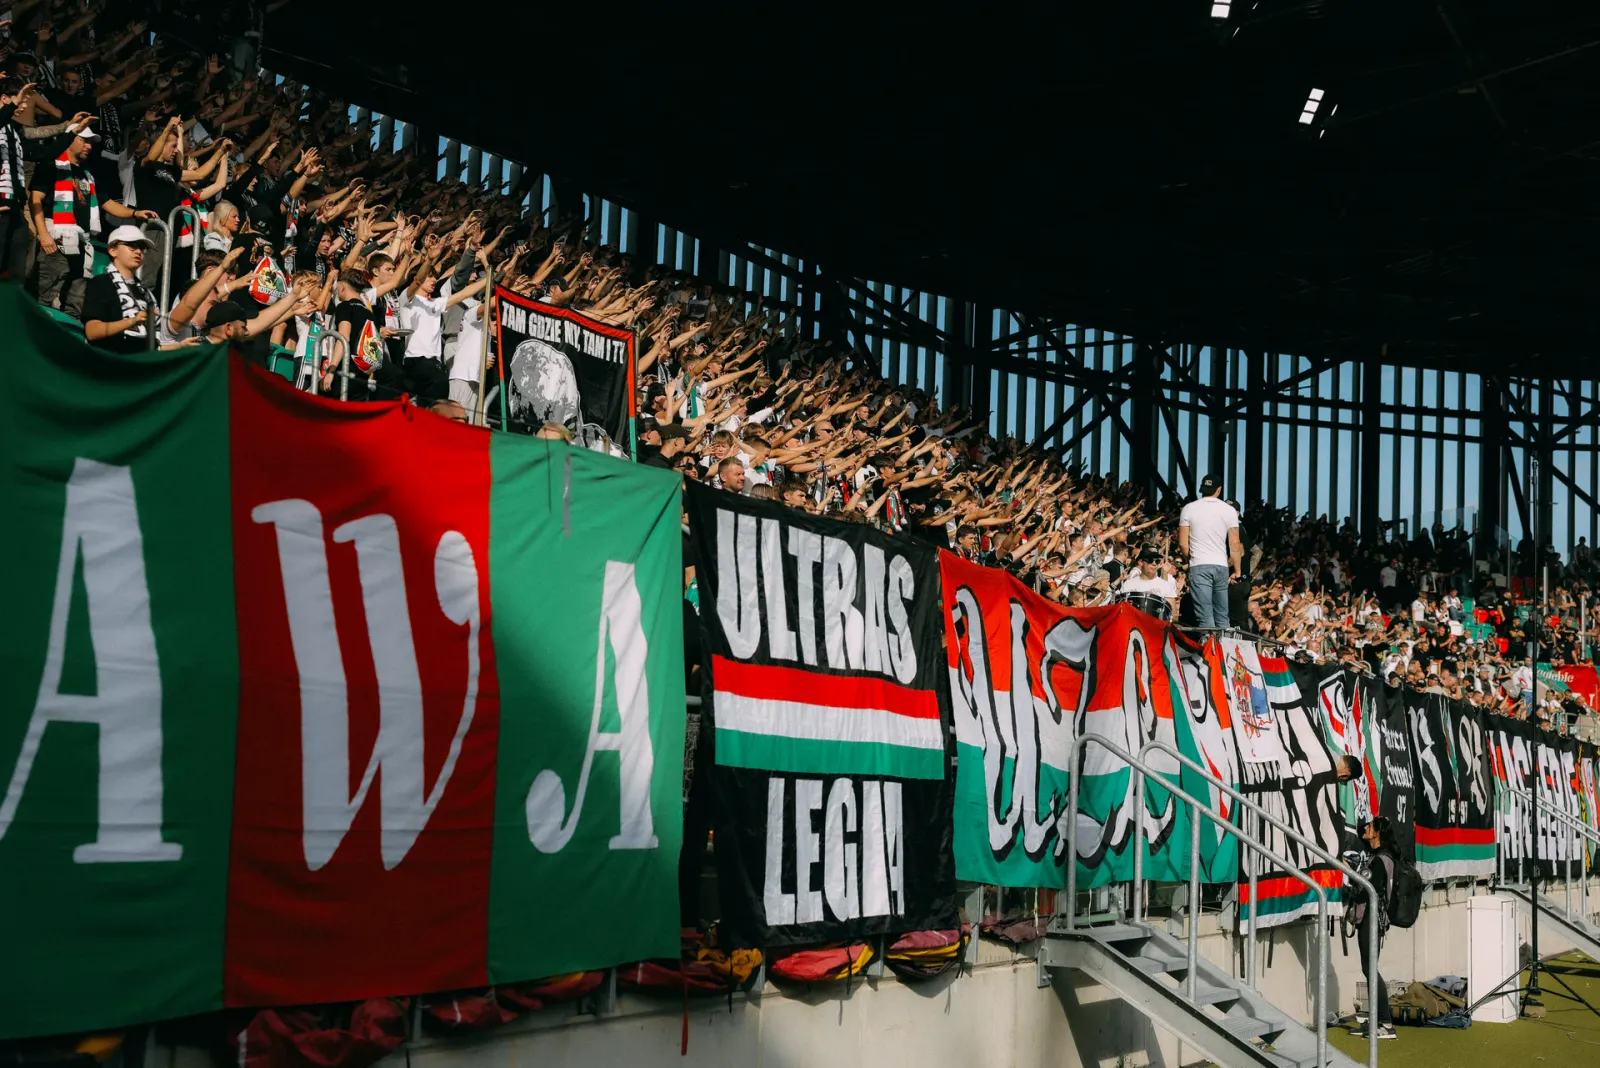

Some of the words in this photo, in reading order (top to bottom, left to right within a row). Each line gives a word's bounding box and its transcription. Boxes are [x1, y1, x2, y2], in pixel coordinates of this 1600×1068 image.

[502, 301, 526, 334] TAM
[529, 313, 561, 343] GDZIE
[583, 329, 605, 360] TAM
[606, 339, 612, 362] I
[612, 340, 626, 364] TY
[717, 508, 917, 684] ULTRAS
[764, 778, 905, 926] LEGIA
[1397, 794, 1407, 823] 97
